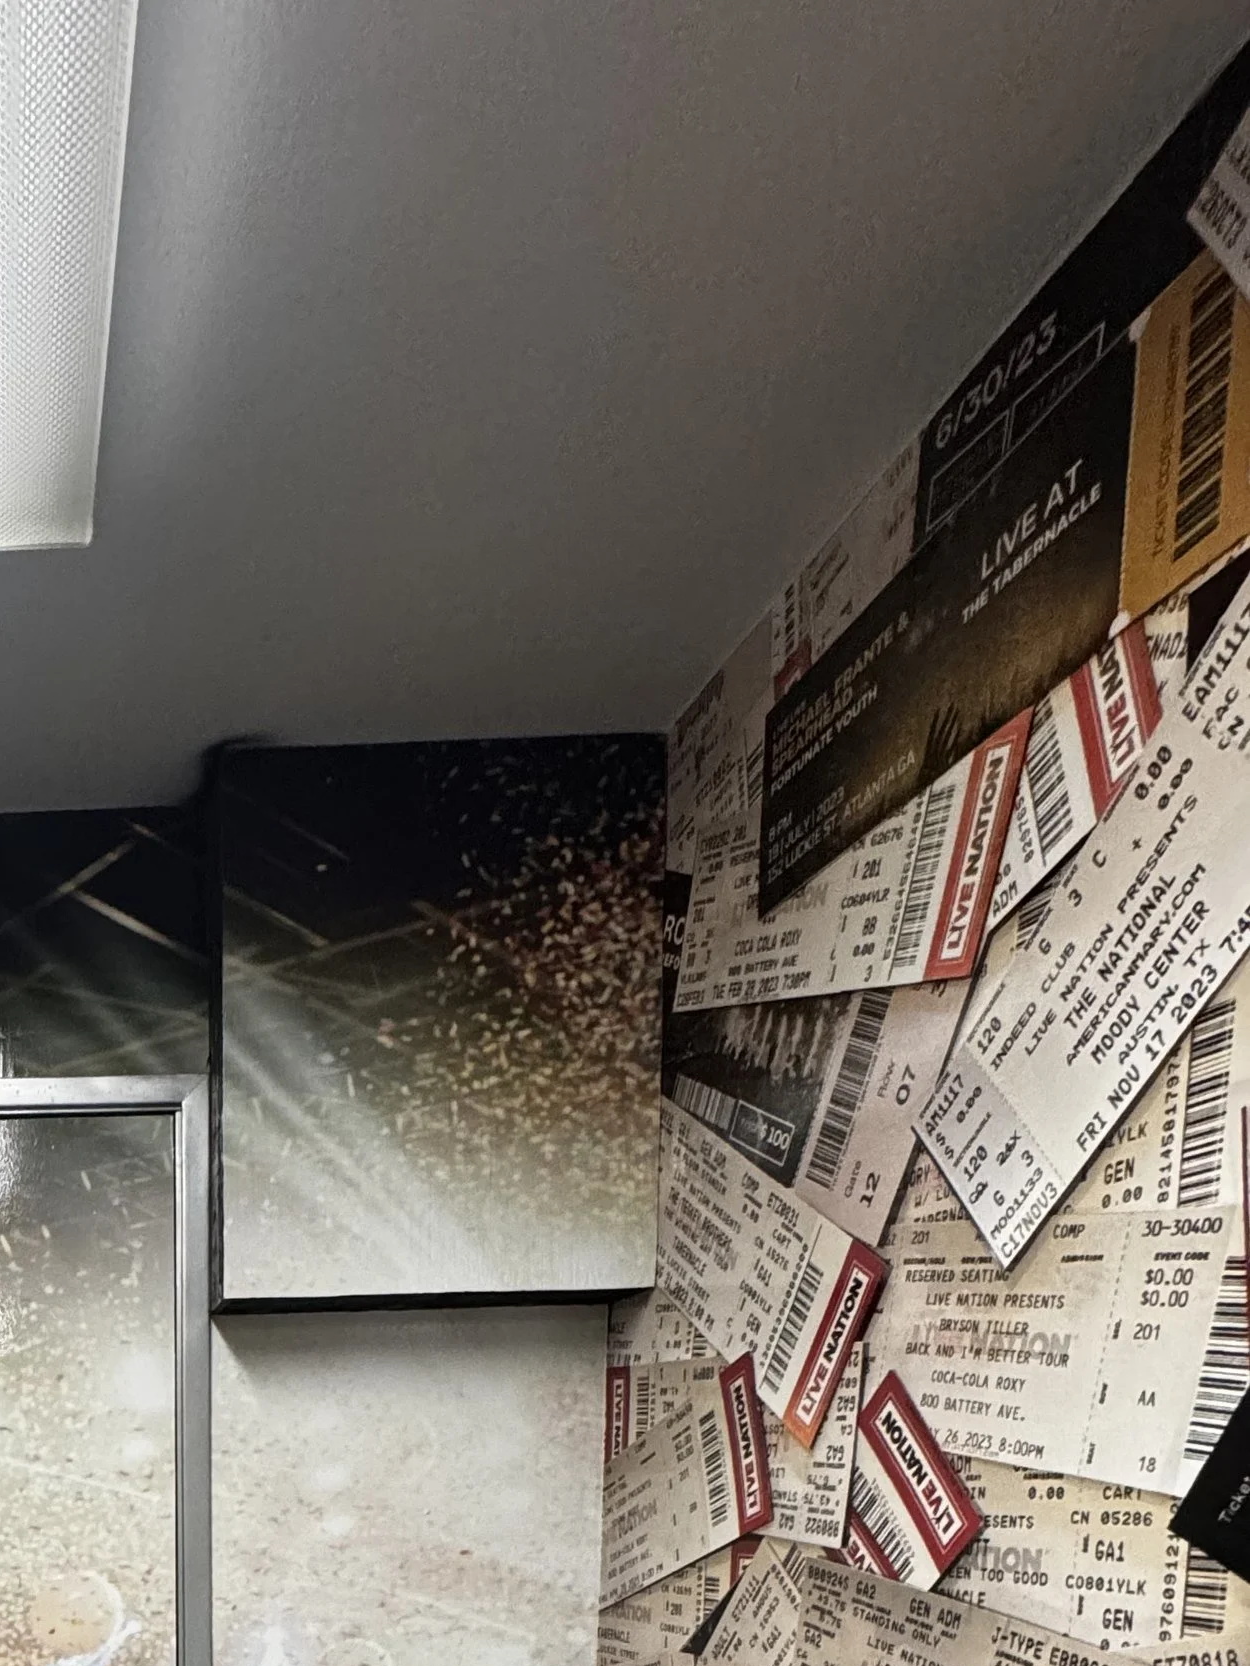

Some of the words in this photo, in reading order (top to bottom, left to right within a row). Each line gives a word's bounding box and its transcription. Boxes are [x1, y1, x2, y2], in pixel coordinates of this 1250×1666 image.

[935, 309, 1058, 450] 6/30/23
[981, 502, 1038, 582] LIVE
[1043, 458, 1084, 520] AT
[961, 588, 989, 625] THE
[992, 482, 1102, 596] TABERNACLE
[835, 684, 879, 734] YOUTH
[1202, 685, 1240, 741] FAC
[1134, 745, 1173, 801] 0.00
[1157, 758, 1194, 811] 0.00
[945, 879, 976, 950] LIVE
[963, 755, 1006, 877] NATION
[1023, 1009, 1059, 1057] LIVE
[1059, 923, 1115, 1003] NATION
[1116, 793, 1199, 915] PRESENTS
[1062, 987, 1098, 1030] THE
[1097, 873, 1177, 983] NATIONAL
[1065, 862, 1207, 1068] AMERICANMARY.COM
[1090, 995, 1143, 1066] MOODY
[1143, 899, 1211, 990] CENTER
[1117, 982, 1181, 1066] AUSTIN,
[1182, 937, 1212, 969] TX
[990, 1000, 1038, 1072] INDEED
[1040, 942, 1077, 994] CLUB
[976, 1015, 1003, 1056] 120
[1075, 1110, 1109, 1154] FRI
[1106, 1063, 1143, 1111] NOV
[1144, 1028, 1168, 1063] 17
[1170, 963, 1220, 1025] 2023
[895, 1062, 918, 1107] 07
[956, 1085, 984, 1125] 0.00
[758, 1121, 791, 1151] $100
[961, 1145, 990, 1183] 120
[1103, 1156, 1136, 1185] GEN
[858, 1171, 882, 1209] 12
[1101, 1186, 1143, 1210] 0.00
[911, 1230, 931, 1245] 201
[1052, 1224, 1086, 1240] COMP
[1141, 1216, 1223, 1239] 30-30400
[904, 1268, 956, 1284] RESERVED
[960, 1268, 1011, 1283] SEATING
[1144, 1267, 1195, 1287] $0.00
[925, 1292, 953, 1307] LIVE
[956, 1294, 1002, 1308] NATION
[1004, 1294, 1066, 1310] PRESENTS
[1140, 1290, 1190, 1309] $0.00
[938, 1318, 981, 1335] BRYSON
[985, 1320, 1030, 1337] TILLER
[1132, 1323, 1161, 1341] 201
[802, 1357, 835, 1418] LIVE
[825, 1276, 864, 1363] NATION
[904, 1341, 931, 1356] BACK
[934, 1343, 956, 1358] AND
[960, 1344, 984, 1360] I'M
[987, 1347, 1033, 1365] BETTER
[1039, 1352, 1070, 1369] TOUR
[930, 1369, 990, 1389] COCA-COLA
[995, 1375, 1027, 1392] ROXY
[1137, 1390, 1156, 1408] AA
[613, 1383, 624, 1420] LIVE
[919, 1392, 941, 1408] 800
[943, 1395, 993, 1416] BATTERY
[996, 1403, 1027, 1422] AVE.
[731, 1383, 754, 1464] NATION
[879, 1409, 928, 1489] NATION
[998, 1436, 1045, 1460] 8:00PM
[1137, 1456, 1156, 1473] 18
[743, 1463, 761, 1510] LIVE
[920, 1473, 956, 1536] LIVE
[1028, 1485, 1066, 1500] 0.00
[1070, 1511, 1090, 1525] CN
[1100, 1510, 1154, 1527] 05286
[1094, 1539, 1126, 1563] GA1
[979, 1567, 1005, 1583] TOO
[1012, 1569, 1049, 1587] GOOD
[851, 1605, 907, 1641] STANDING
[911, 1627, 942, 1649] ONLY
[855, 1580, 877, 1600] GA2
[908, 1598, 932, 1620] GEN
[937, 1607, 963, 1629] ADM
[990, 1626, 1044, 1662] J-TYPE
[1101, 1609, 1135, 1632] GEN
[866, 1635, 895, 1656] LIVE
